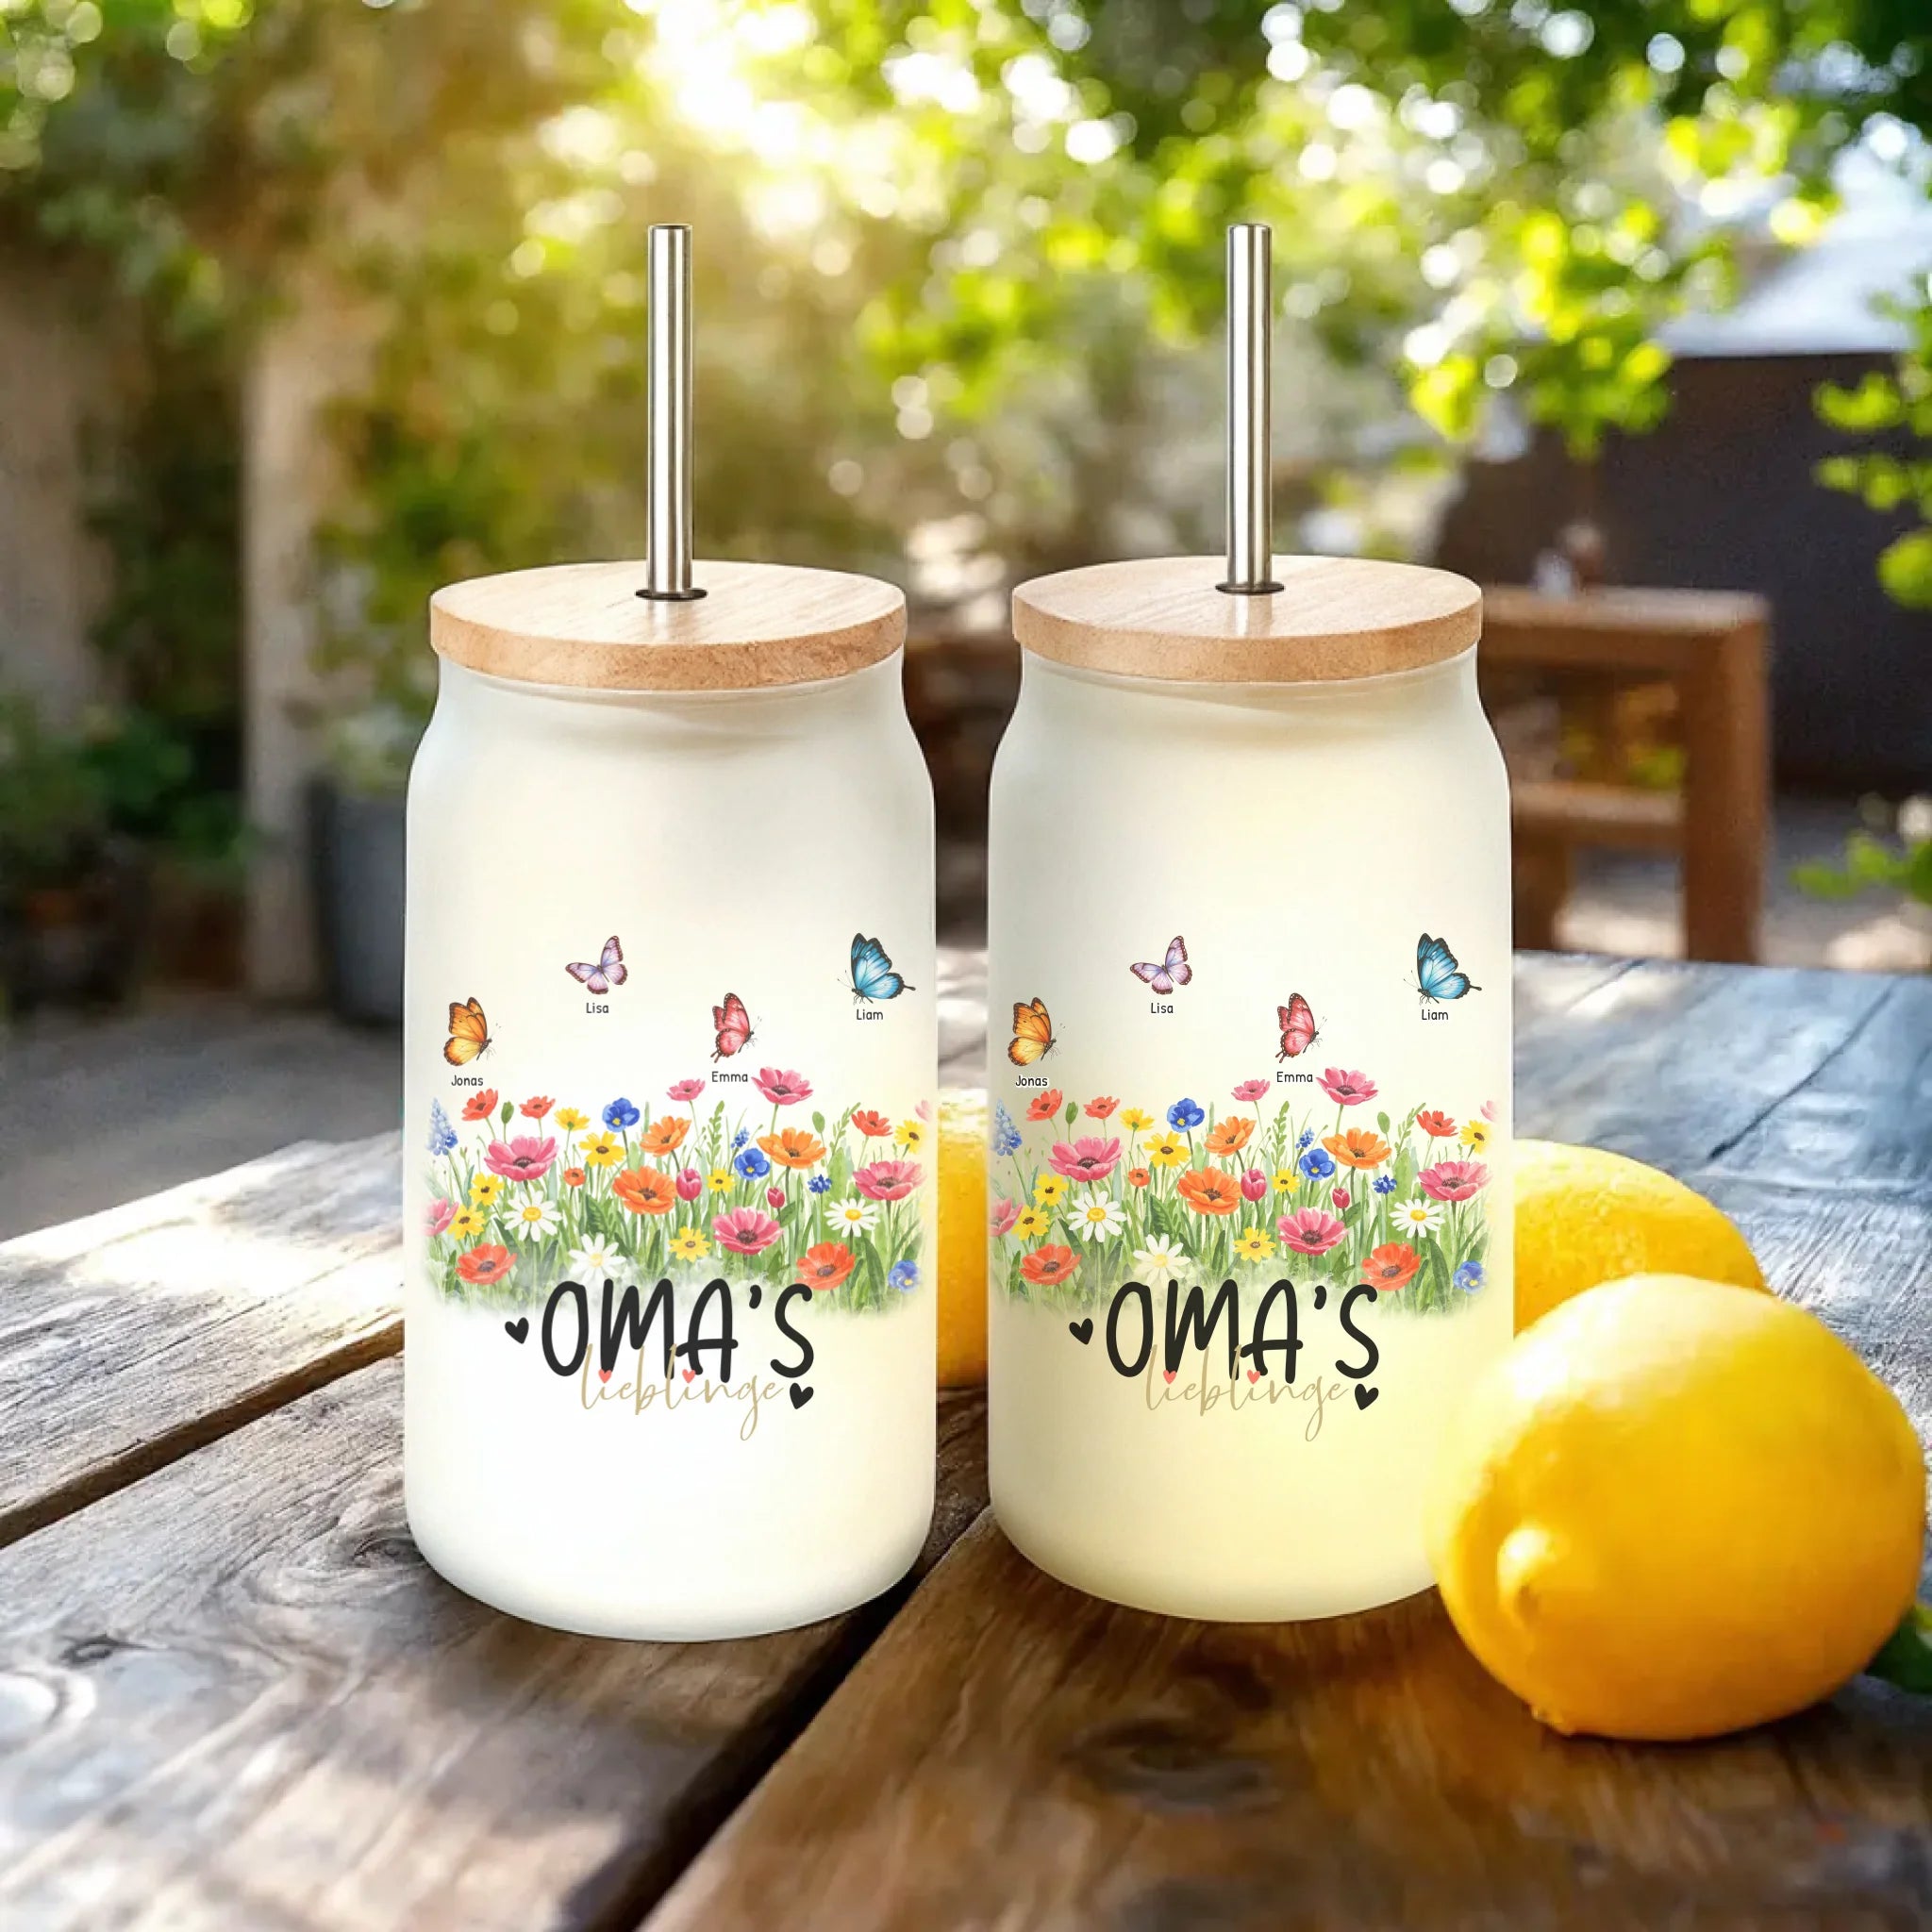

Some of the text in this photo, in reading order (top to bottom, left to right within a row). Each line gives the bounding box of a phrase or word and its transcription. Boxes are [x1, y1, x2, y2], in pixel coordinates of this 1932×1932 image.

[586, 1002, 610, 1014] Lisa
[856, 1008, 885, 1021] Liam
[1150, 1002, 1174, 1014] Lisa
[1421, 1008, 1450, 1021] Liam
[451, 1074, 484, 1088] Jonas
[711, 1071, 749, 1084] Emma
[1015, 1074, 1049, 1089] Jonas
[1275, 1071, 1314, 1084] Emma
[541, 1278, 814, 1383] OMA'S
[1105, 1279, 1380, 1384] OMA'S
[580, 1342, 785, 1441] lieblinge
[1145, 1343, 1349, 1442] lieblinge
